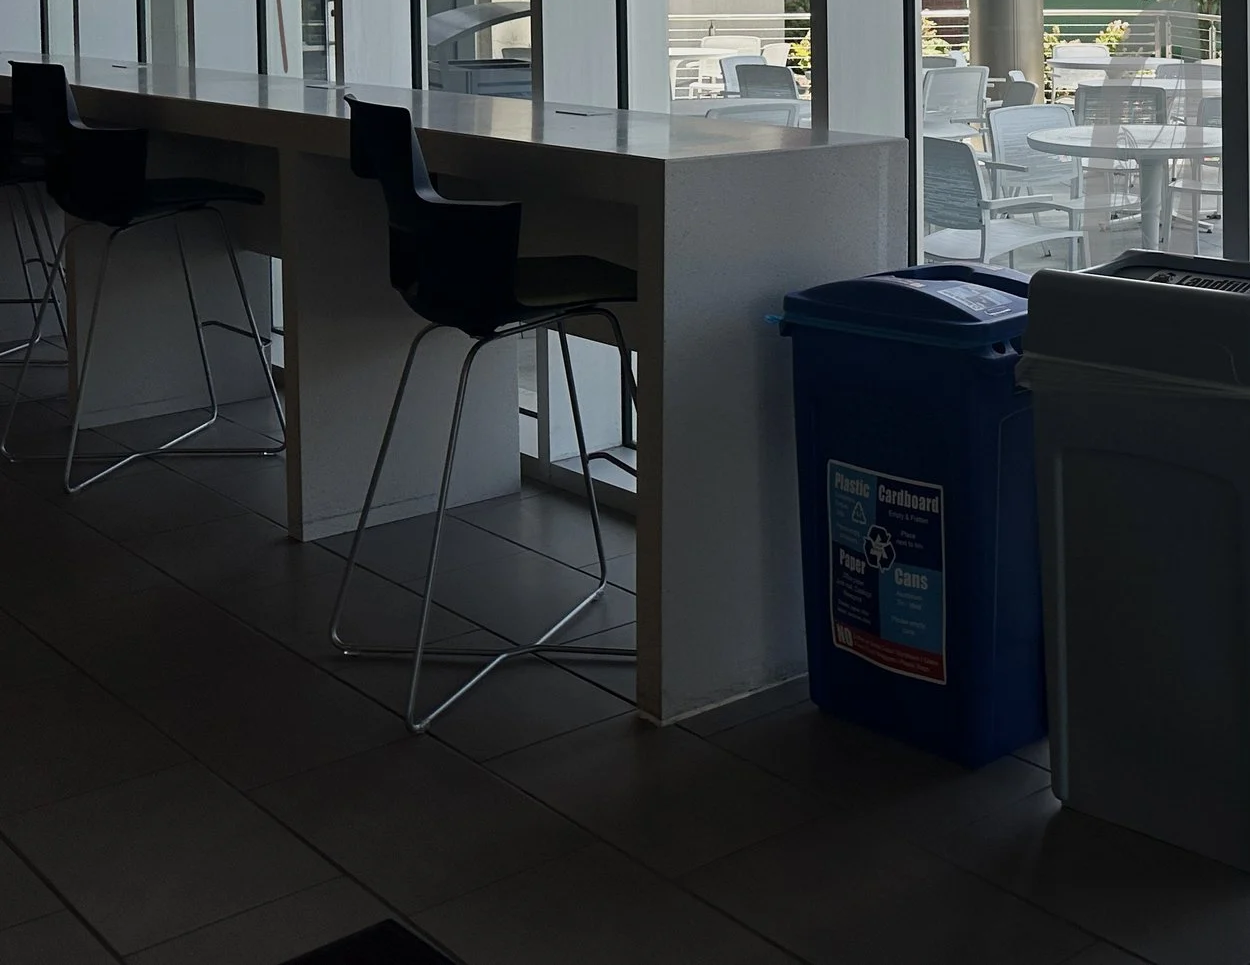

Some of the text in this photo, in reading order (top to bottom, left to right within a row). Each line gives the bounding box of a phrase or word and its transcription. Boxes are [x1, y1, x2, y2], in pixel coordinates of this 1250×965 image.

[834, 470, 870, 499] Plastic
[878, 484, 940, 514] Cardboard
[839, 547, 867, 576] Paper
[894, 567, 929, 590] Cans
[835, 623, 854, 647] NO
